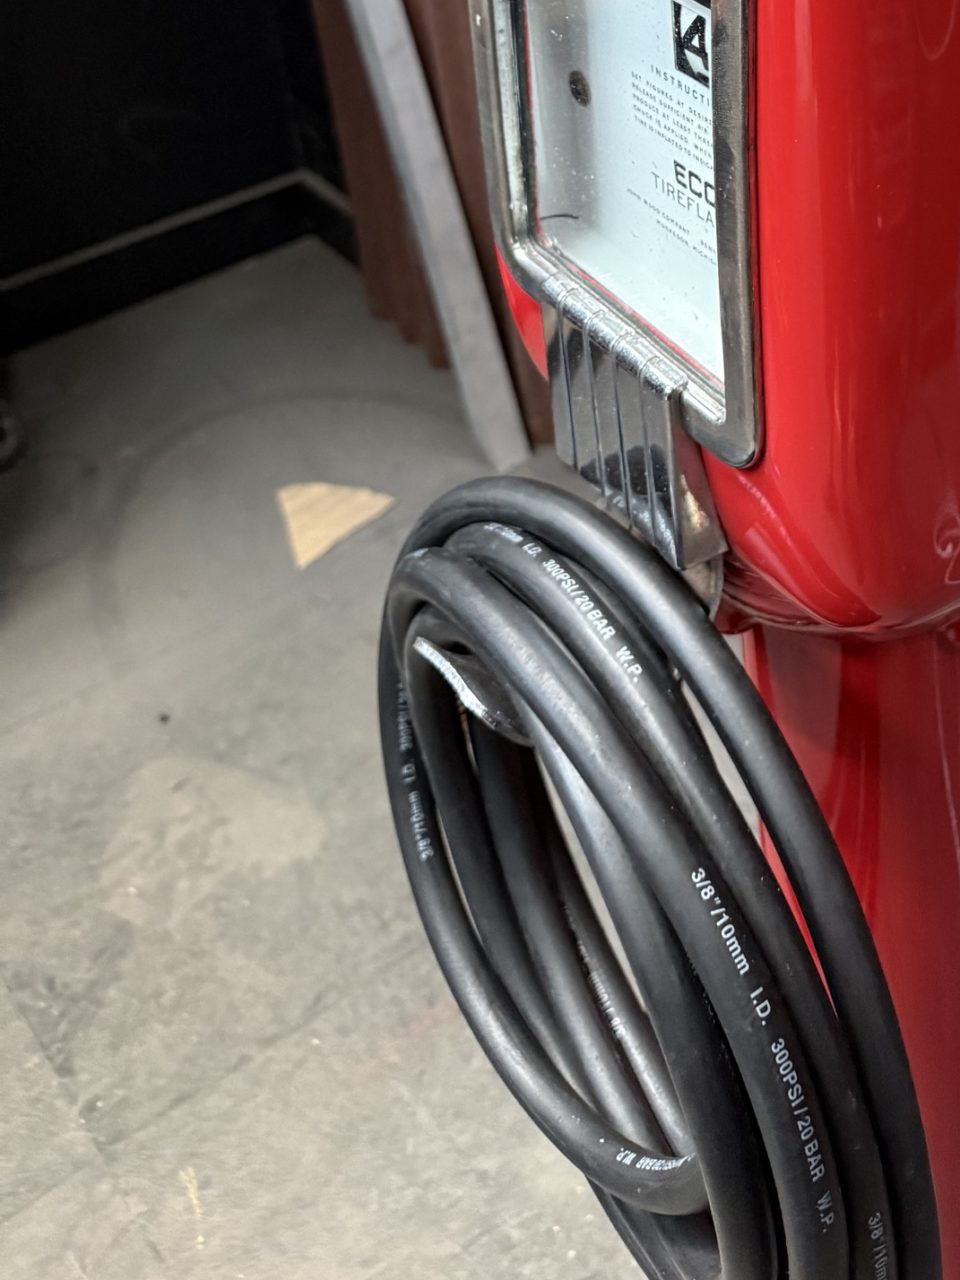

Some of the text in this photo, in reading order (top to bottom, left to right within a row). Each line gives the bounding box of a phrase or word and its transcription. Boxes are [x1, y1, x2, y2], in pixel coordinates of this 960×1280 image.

[650, 170, 715, 228] TIREFLA
[615, 645, 643, 683] W.P.
[691, 867, 750, 976] 3/8"/10mm
[750, 986, 772, 1026] I.D.
[816, 1189, 835, 1233] W.P.
